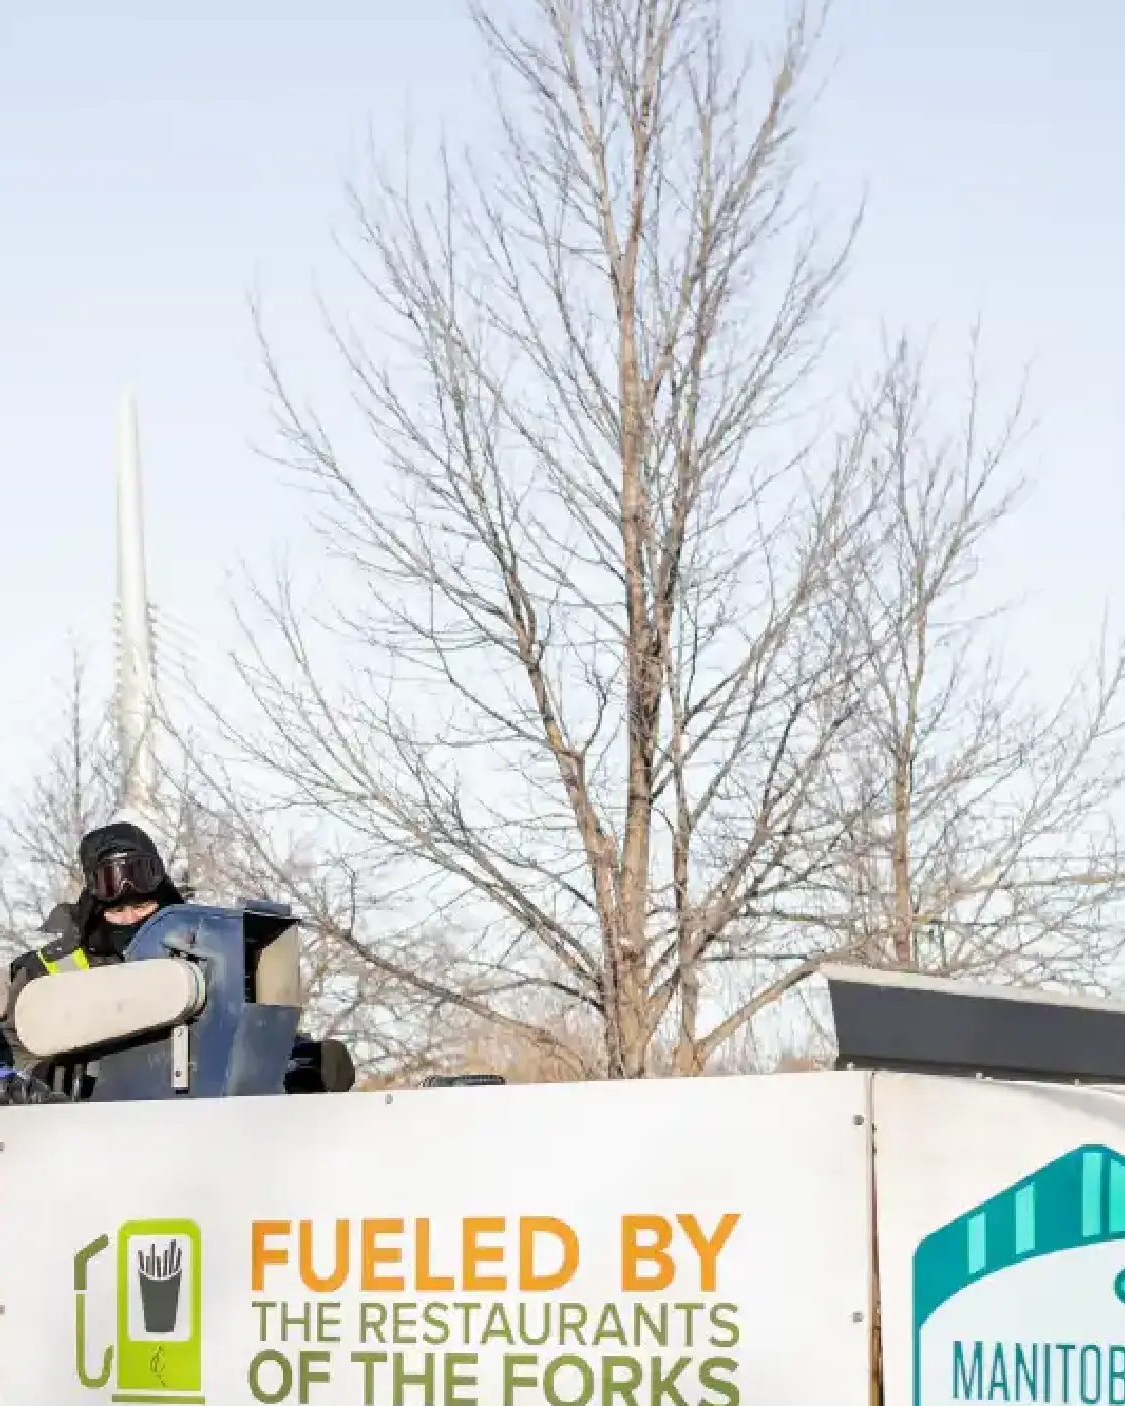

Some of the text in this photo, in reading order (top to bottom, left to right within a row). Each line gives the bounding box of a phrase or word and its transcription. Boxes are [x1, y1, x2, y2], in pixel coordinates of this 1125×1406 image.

[252, 1214, 741, 1292] FUELED BY
[252, 1301, 740, 1348] THE RESTAURANTS
[248, 1349, 331, 1405] OF
[953, 1341, 1125, 1405] MANITOB
